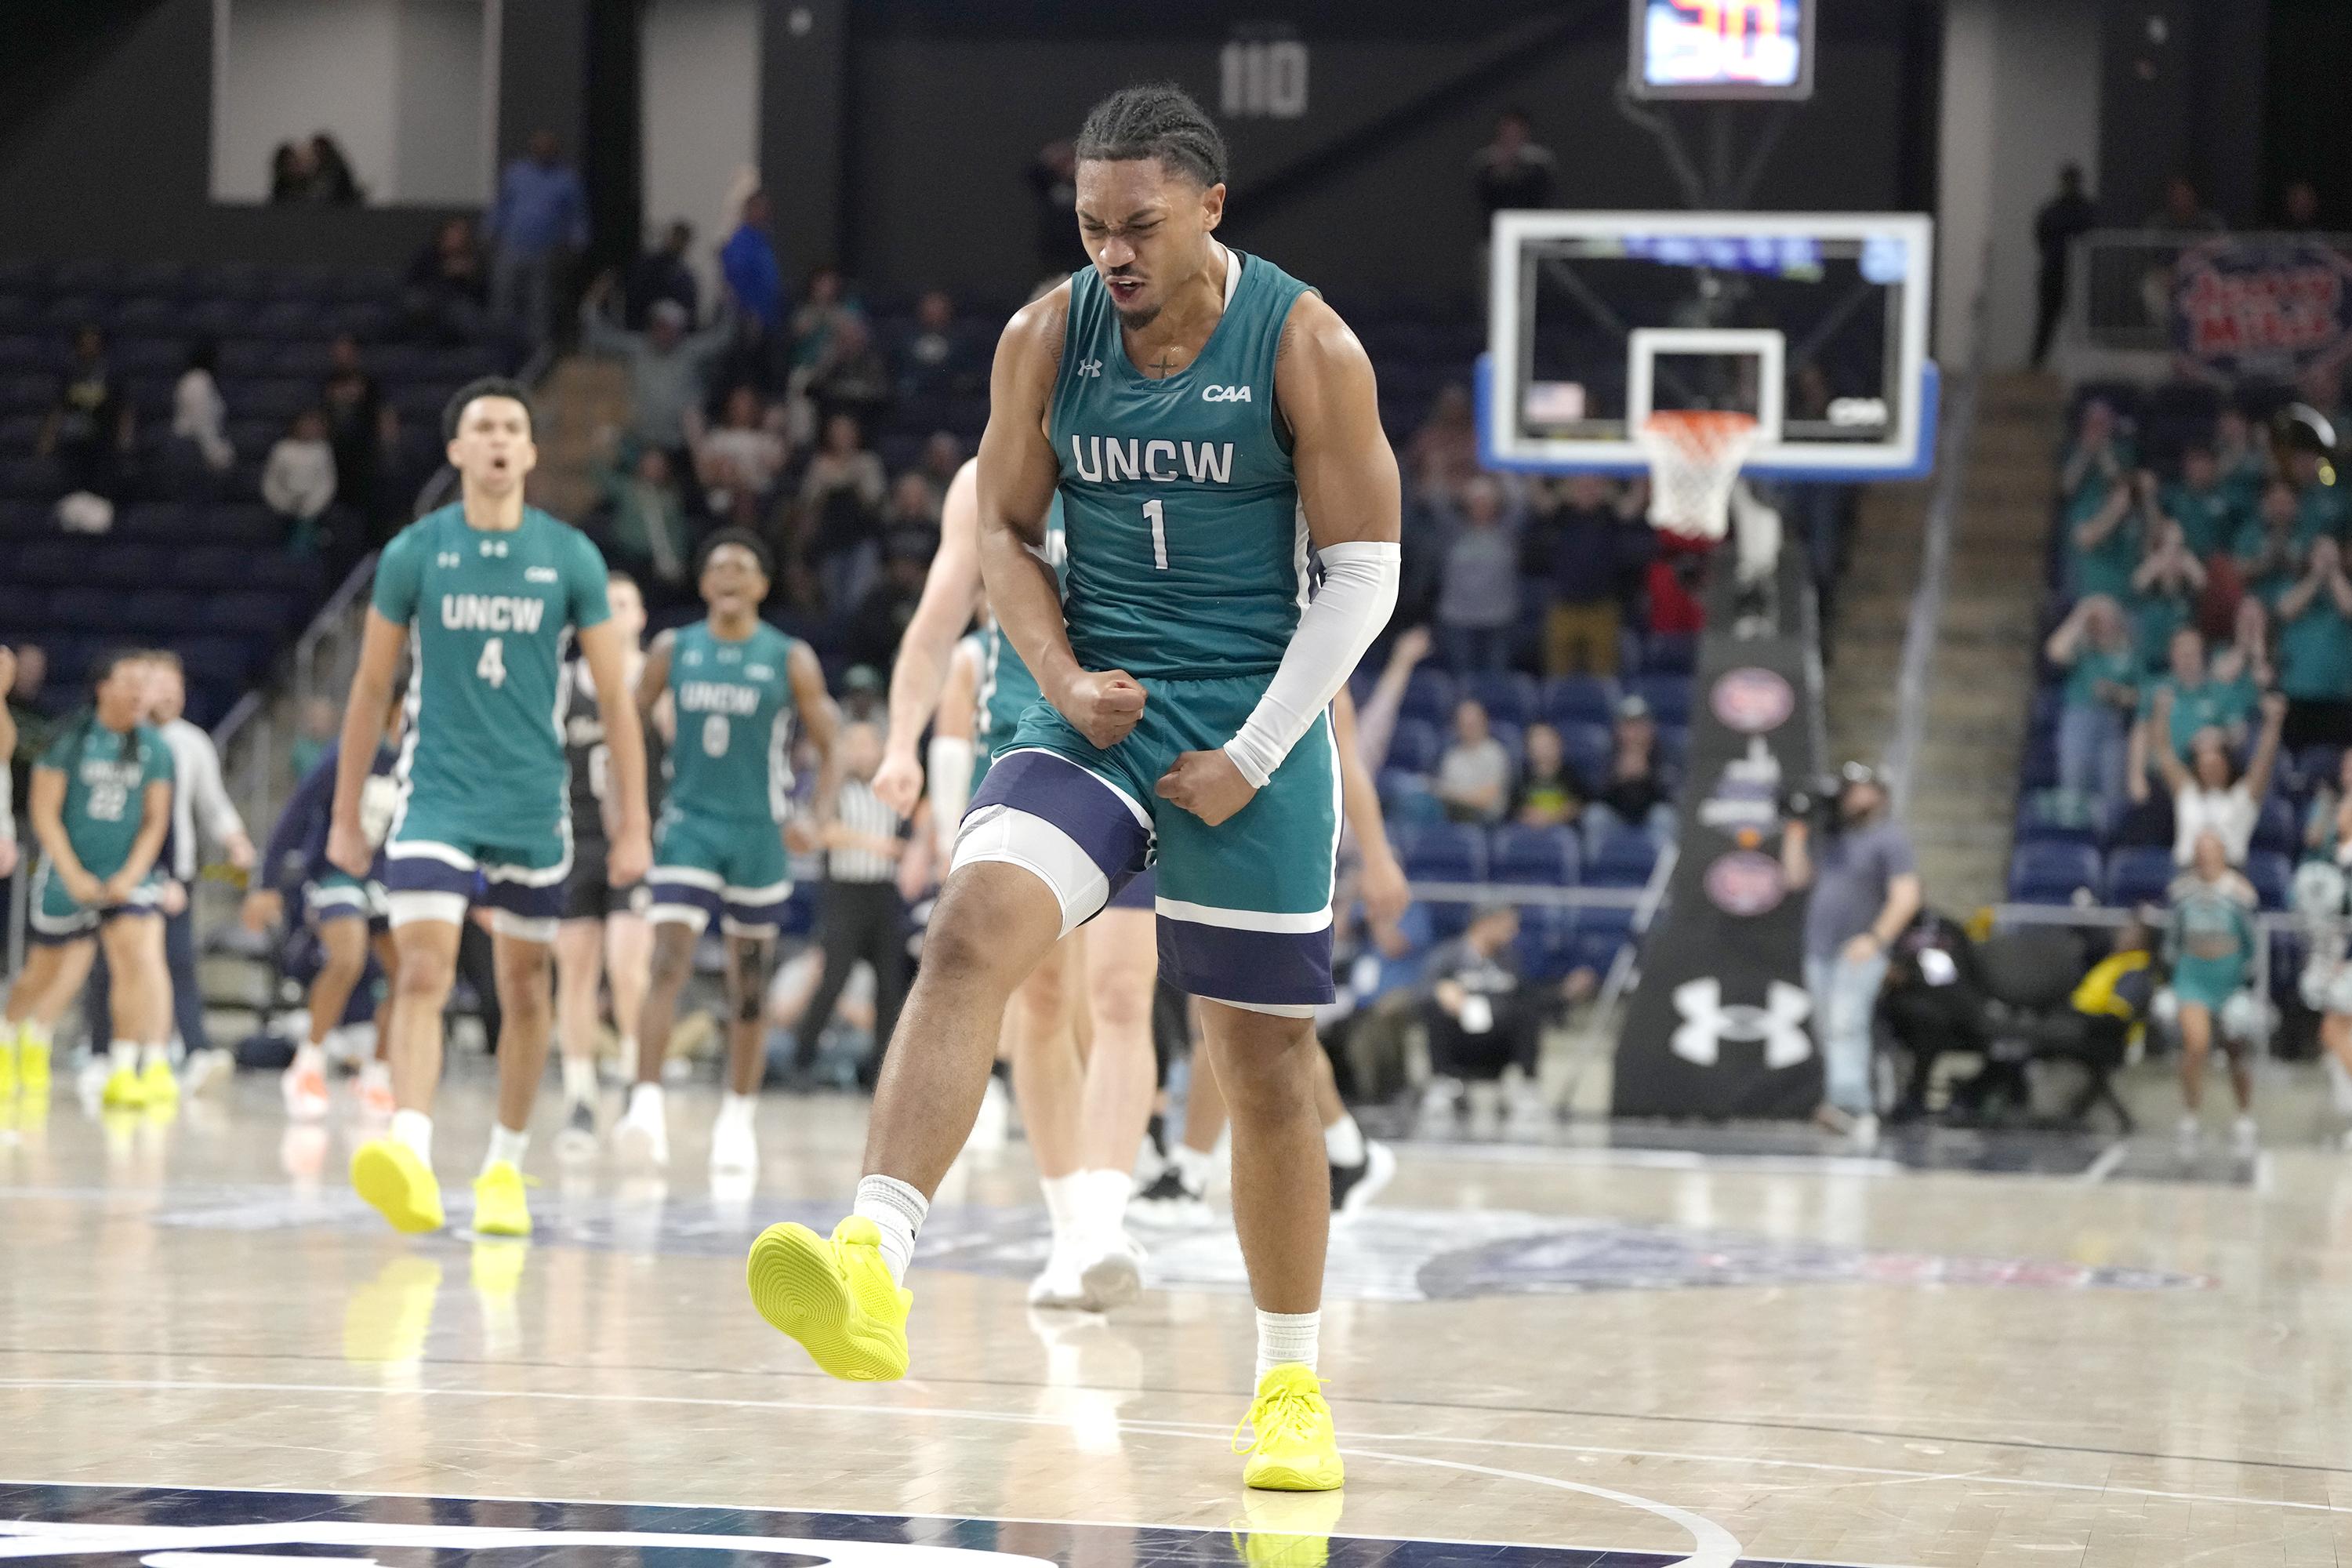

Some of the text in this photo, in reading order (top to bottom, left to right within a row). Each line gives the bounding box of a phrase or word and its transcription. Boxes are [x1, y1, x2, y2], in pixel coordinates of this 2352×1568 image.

[1221, 42, 1308, 116] 110
[1202, 384, 1252, 403] CAA
[1072, 434, 1234, 483] UNCW
[1142, 499, 1169, 570] 1
[441, 594, 544, 633] UNCW
[476, 637, 507, 689] 4
